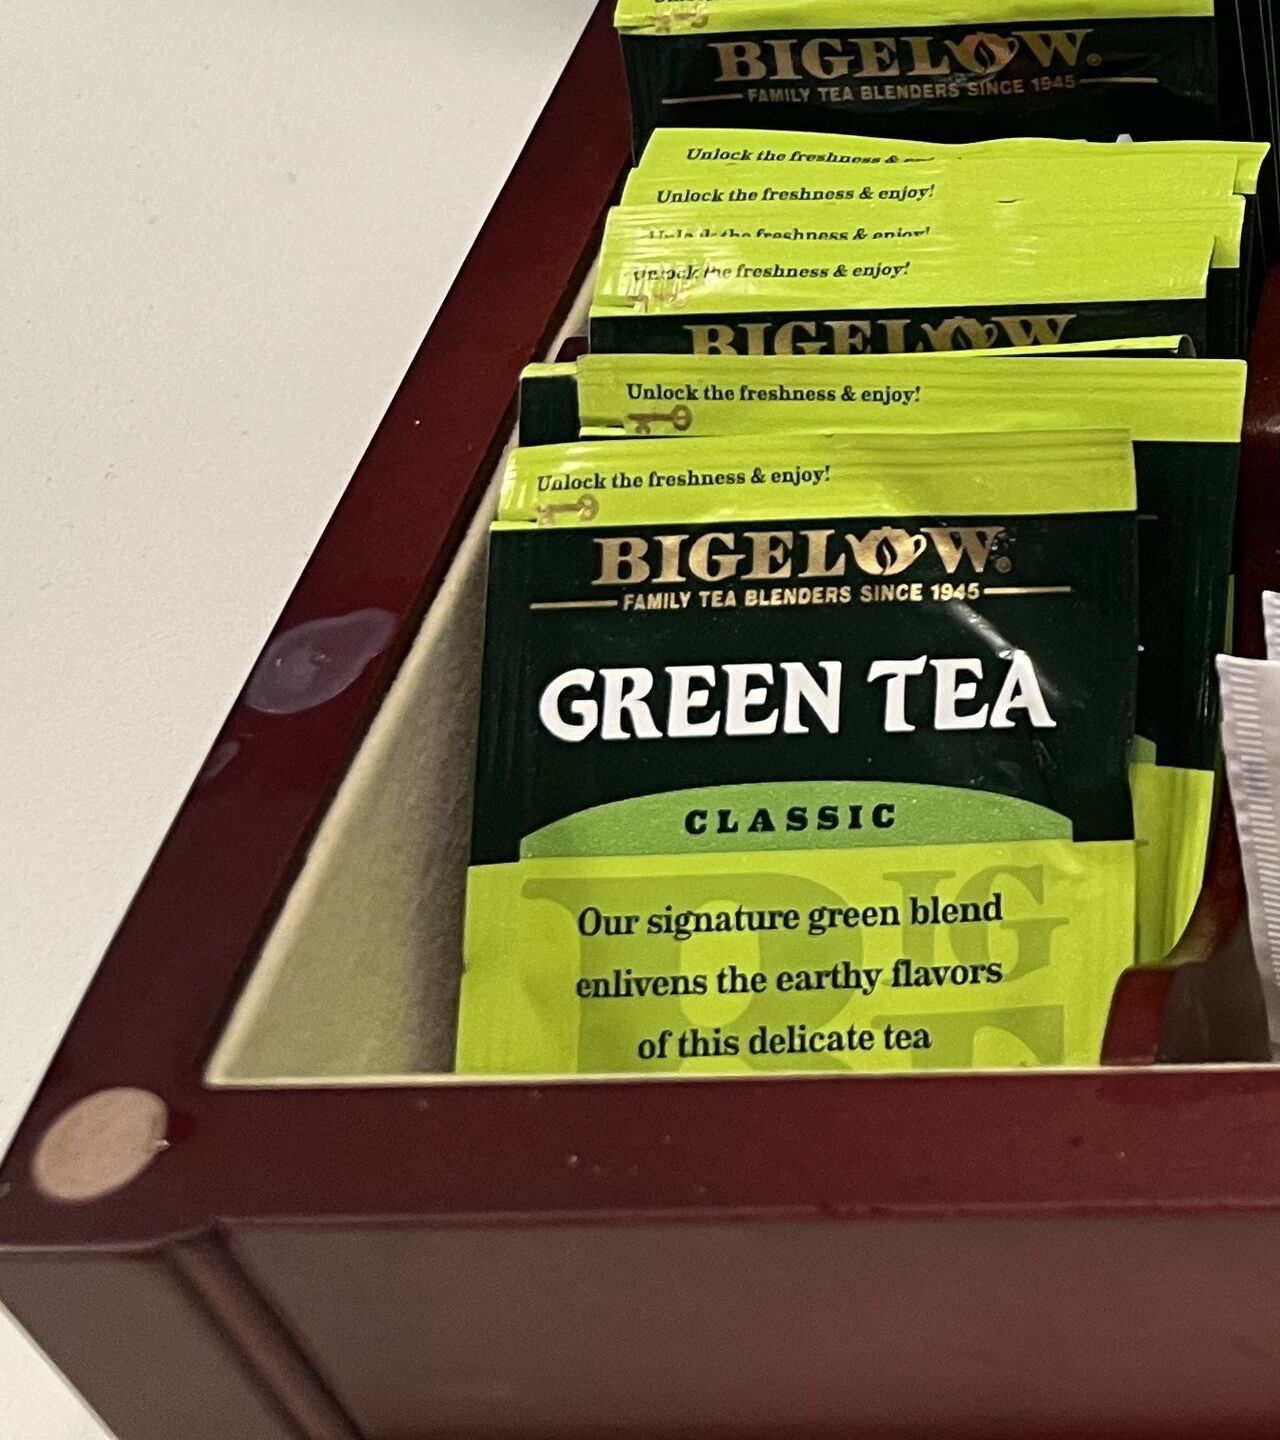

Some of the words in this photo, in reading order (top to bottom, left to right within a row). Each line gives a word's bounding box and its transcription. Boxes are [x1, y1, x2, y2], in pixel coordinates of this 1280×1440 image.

[748, 88, 813, 103] FAMILY
[818, 87, 853, 102] TEA
[861, 83, 960, 99] BLENDERS
[968, 79, 1024, 95] SINCE
[1031, 76, 1075, 90] 1945
[657, 190, 724, 204] Unlock
[728, 189, 757, 201] the
[762, 187, 854, 201] freshness
[859, 187, 873, 200] &
[877, 184, 935, 202] enjoy!
[736, 264, 827, 278] freshness
[852, 262, 910, 279] enjoy!
[626, 384, 699, 400] Unlock
[704, 384, 734, 400] the
[740, 384, 835, 401] freshness
[841, 386, 855, 401] &
[861, 386, 920, 405] enjoy!
[537, 474, 606, 492] Unlock
[612, 472, 642, 488] the
[648, 470, 745, 487] freshness
[751, 468, 765, 483] &
[771, 465, 830, 485] enjoy!
[623, 592, 690, 611] FAMILY
[699, 591, 736, 608] TEA
[745, 587, 851, 606] BLENDERS
[861, 584, 923, 602] SINCE
[931, 584, 980, 601] 1945
[538, 661, 842, 742] GREEN
[867, 649, 1057, 733] TEA
[685, 804, 895, 834] CLASSIC
[578, 907, 639, 936] Our
[647, 905, 800, 941] signature
[808, 905, 899, 935] green
[911, 893, 1002, 925] blend
[576, 969, 707, 998] enlivens
[717, 966, 766, 994] the
[777, 961, 882, 995] earthy
[892, 959, 1003, 987] flavors
[638, 1030, 671, 1059] of
[678, 1028, 739, 1057] this
[749, 1024, 874, 1054] delicate
[883, 1023, 932, 1049] tea
